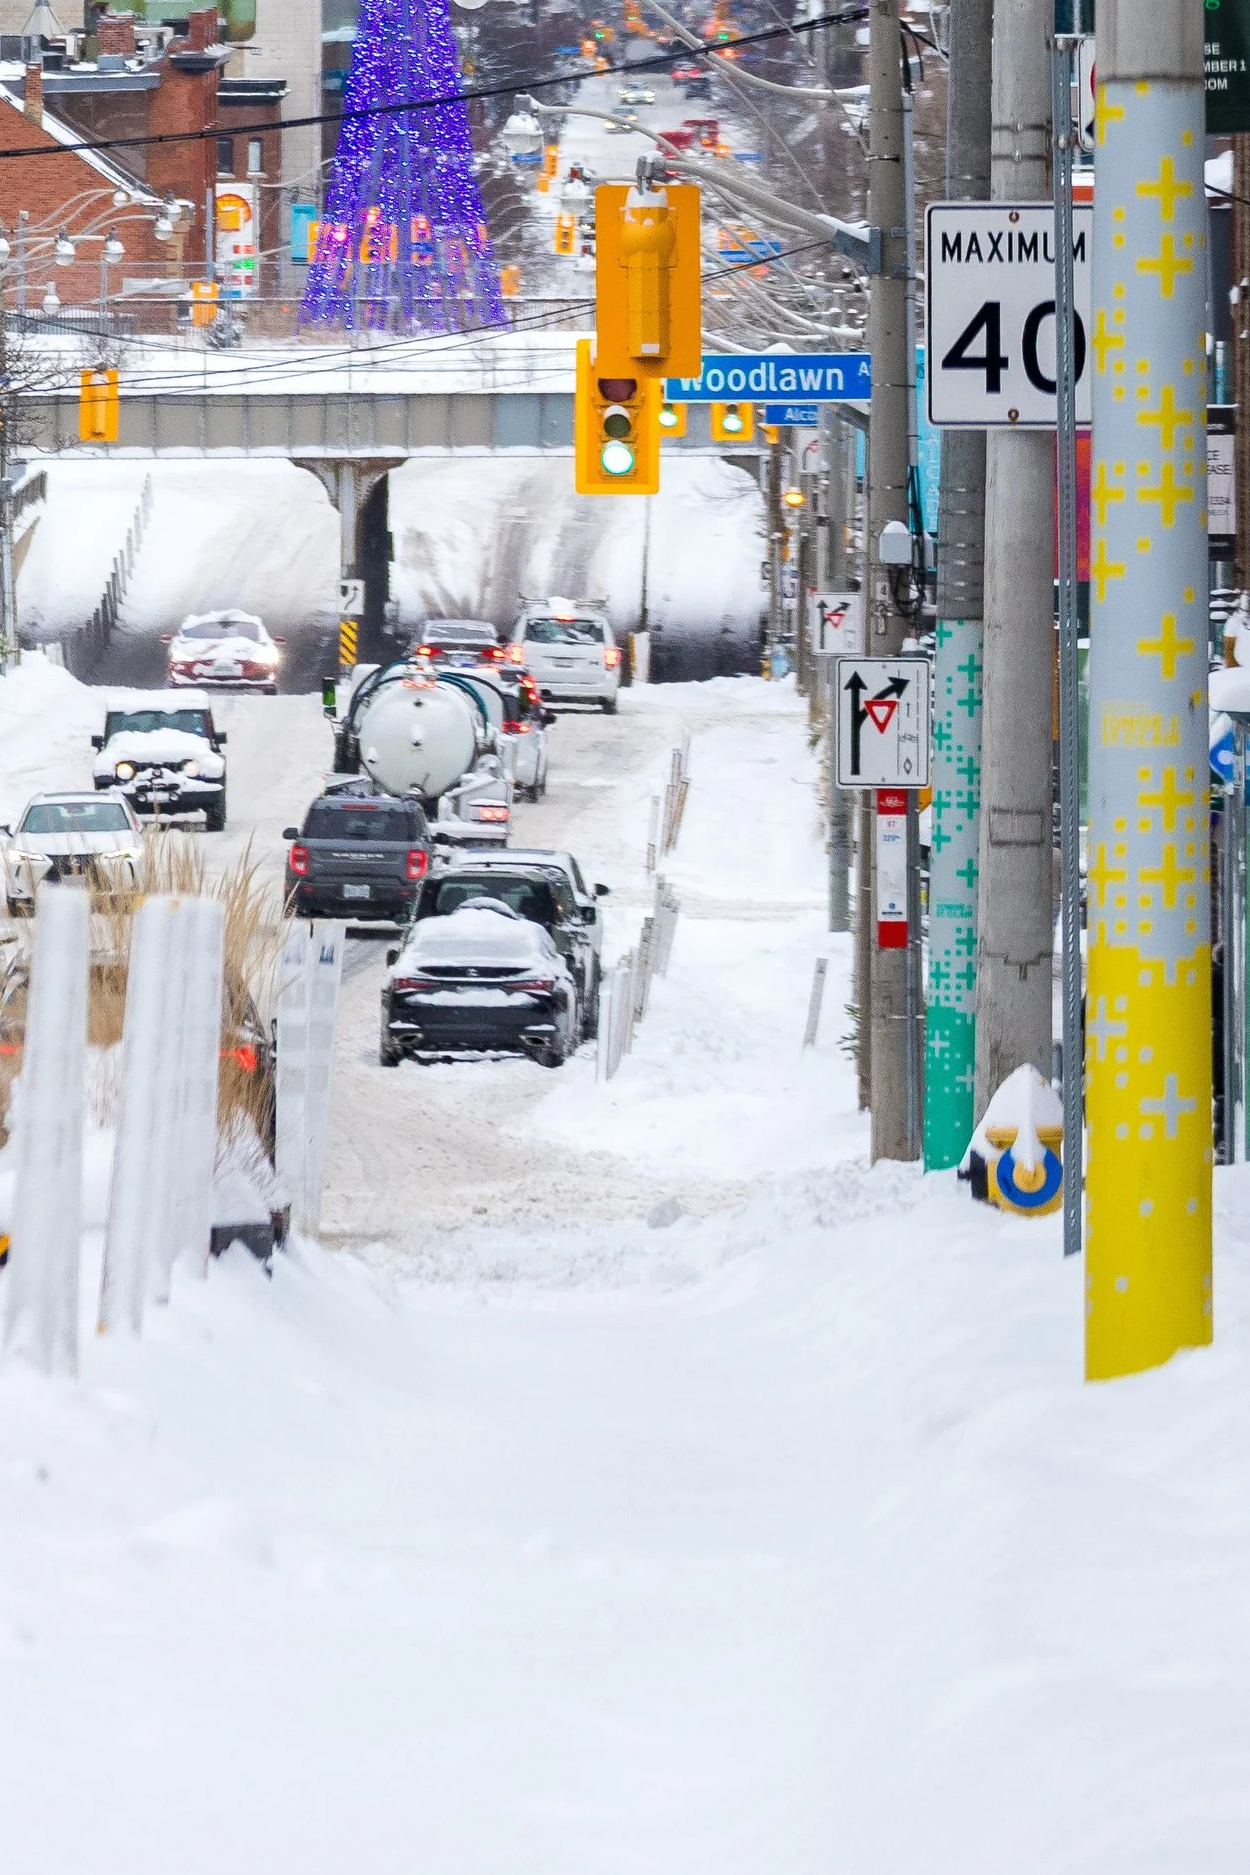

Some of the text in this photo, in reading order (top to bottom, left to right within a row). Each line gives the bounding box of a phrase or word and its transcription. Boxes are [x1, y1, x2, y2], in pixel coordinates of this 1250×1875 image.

[1240, 59, 1247, 72] 1
[1205, 78, 1228, 90] OM
[941, 231, 1086, 263] MAXIMUM
[941, 300, 1086, 395] 40
[678, 361, 844, 392] Woodlawn
